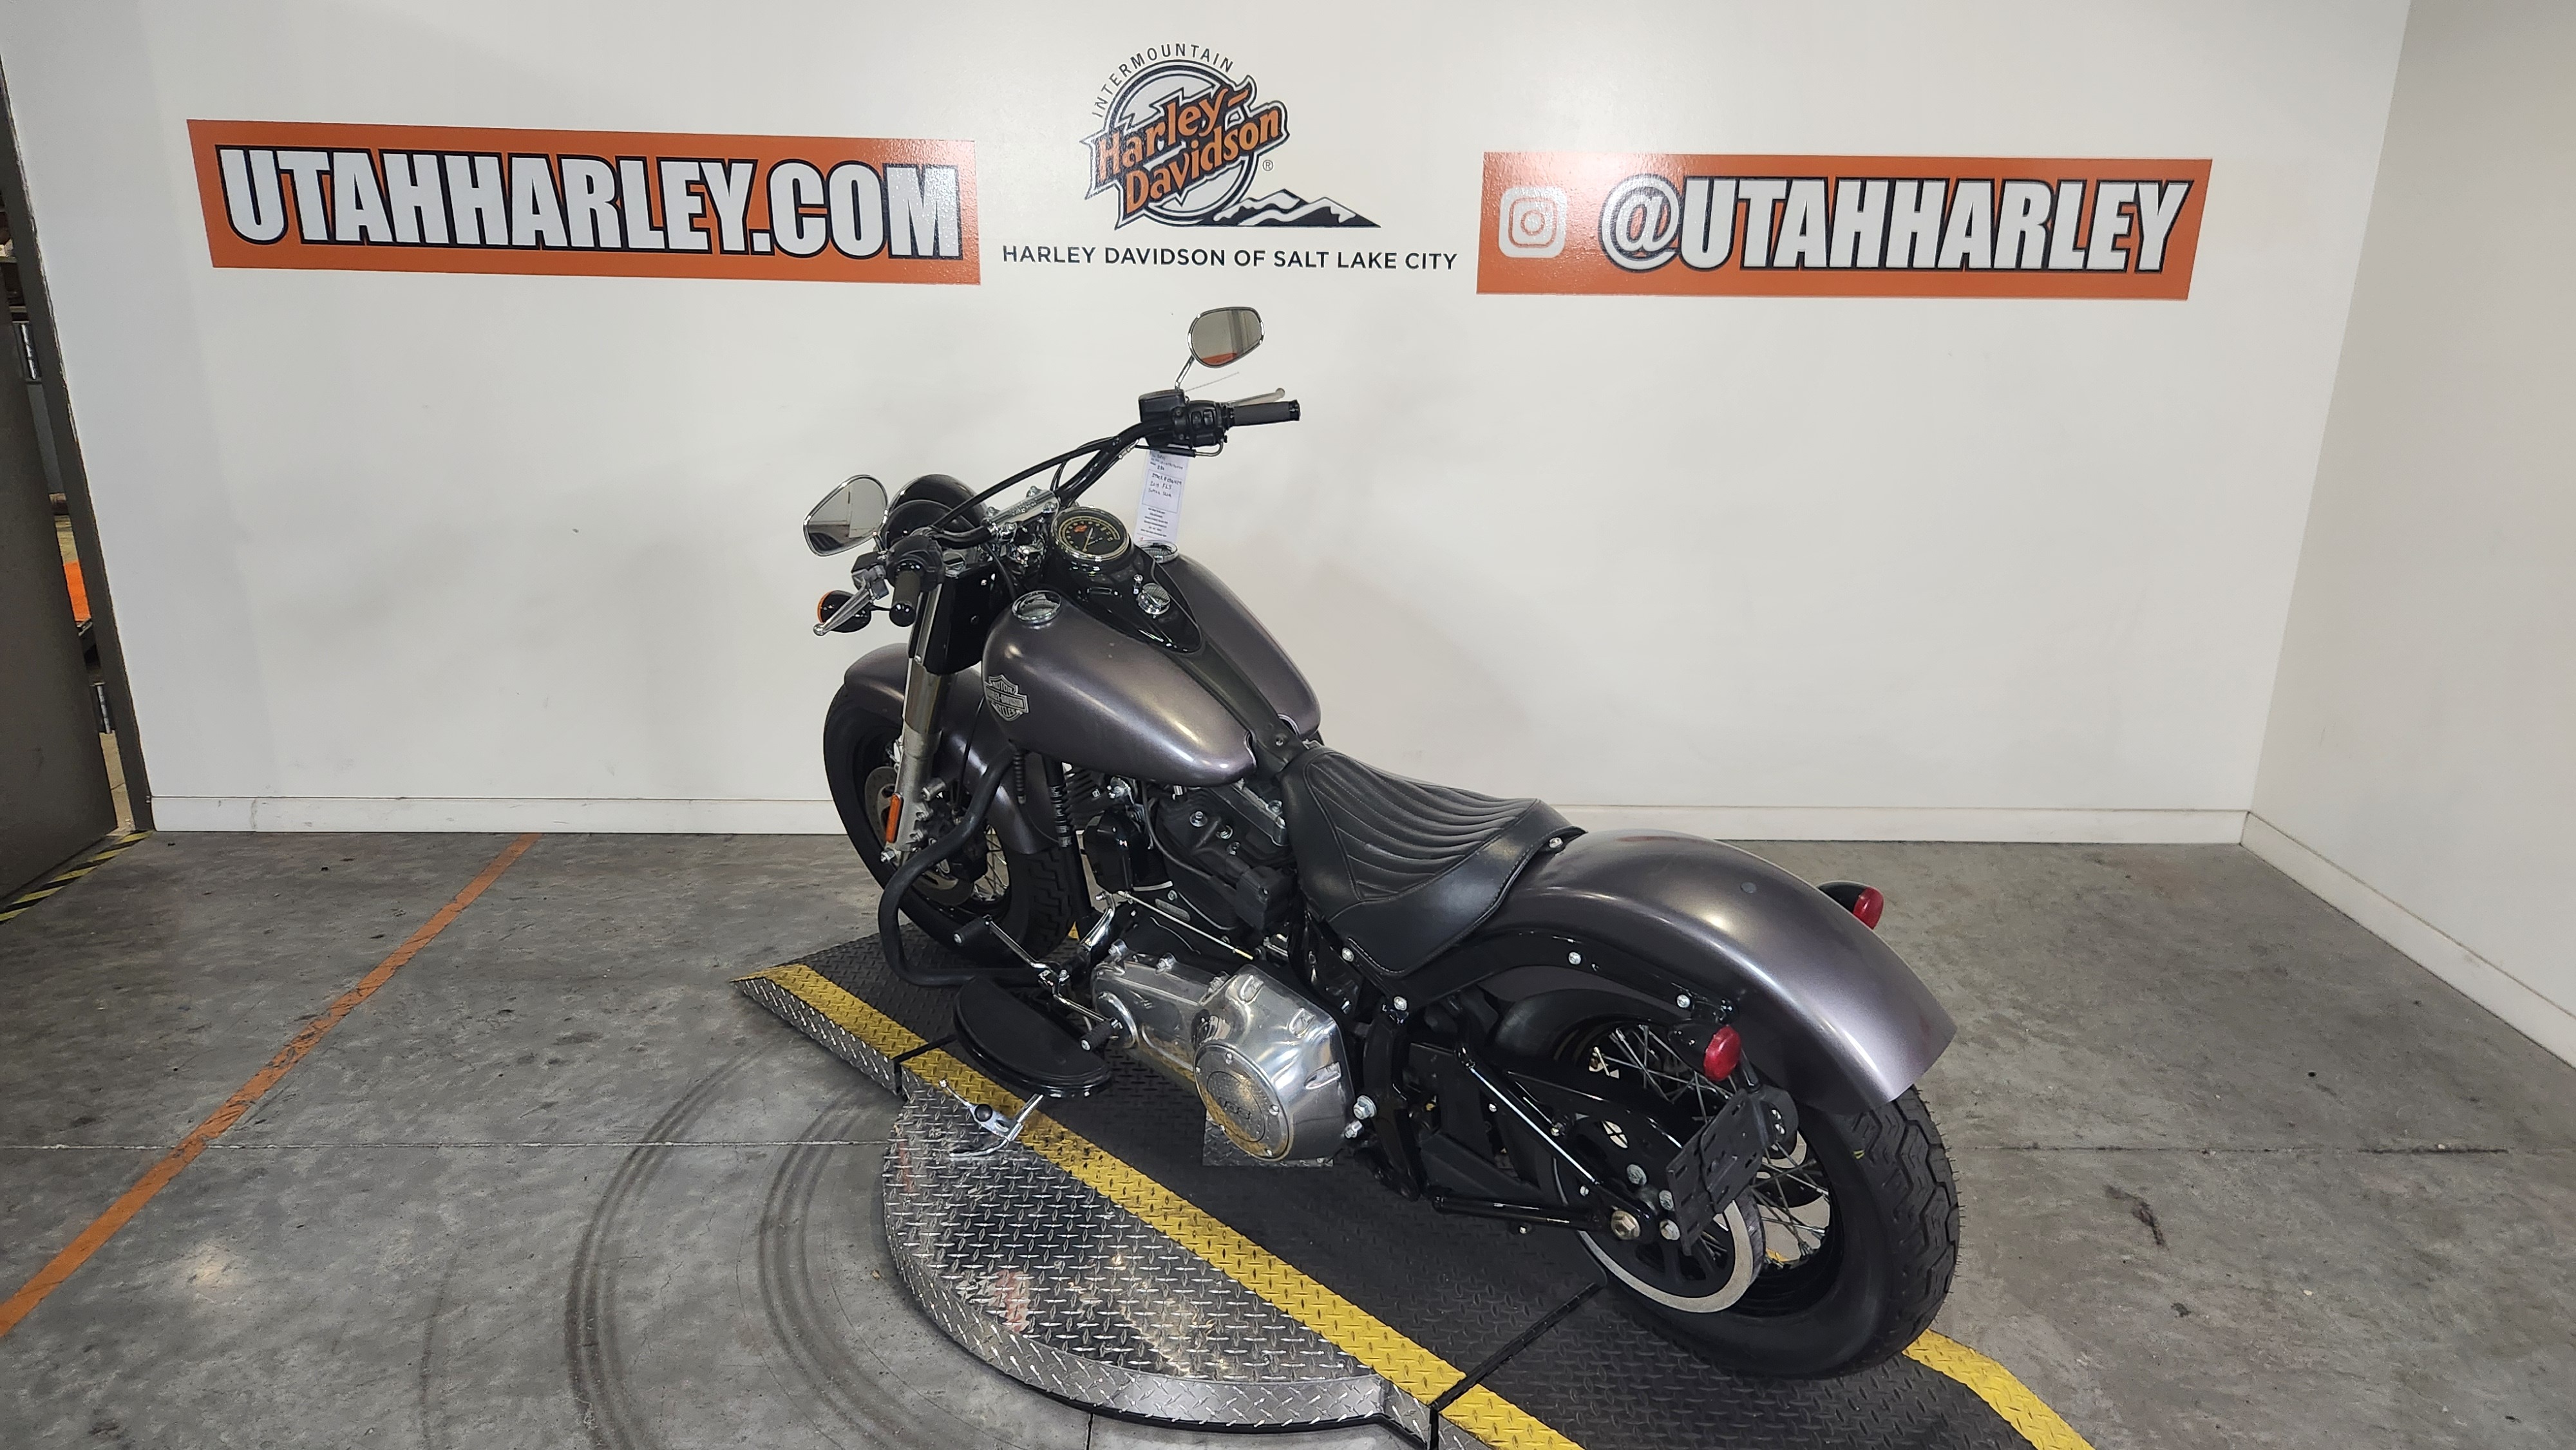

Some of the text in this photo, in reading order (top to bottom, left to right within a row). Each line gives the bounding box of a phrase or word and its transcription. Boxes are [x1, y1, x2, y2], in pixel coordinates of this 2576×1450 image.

[1092, 43, 1234, 118] INTERMOUNTAIN
[1097, 88, 1249, 183] Harley-
[1126, 109, 1279, 214] Davidson
[215, 144, 964, 259] UTAHHARLEY.COM
[1598, 174, 2195, 272] @UTAHHARLEY
[1002, 245, 1459, 270] HARLEY DAVIDSON OF SALT LAKE CITY
